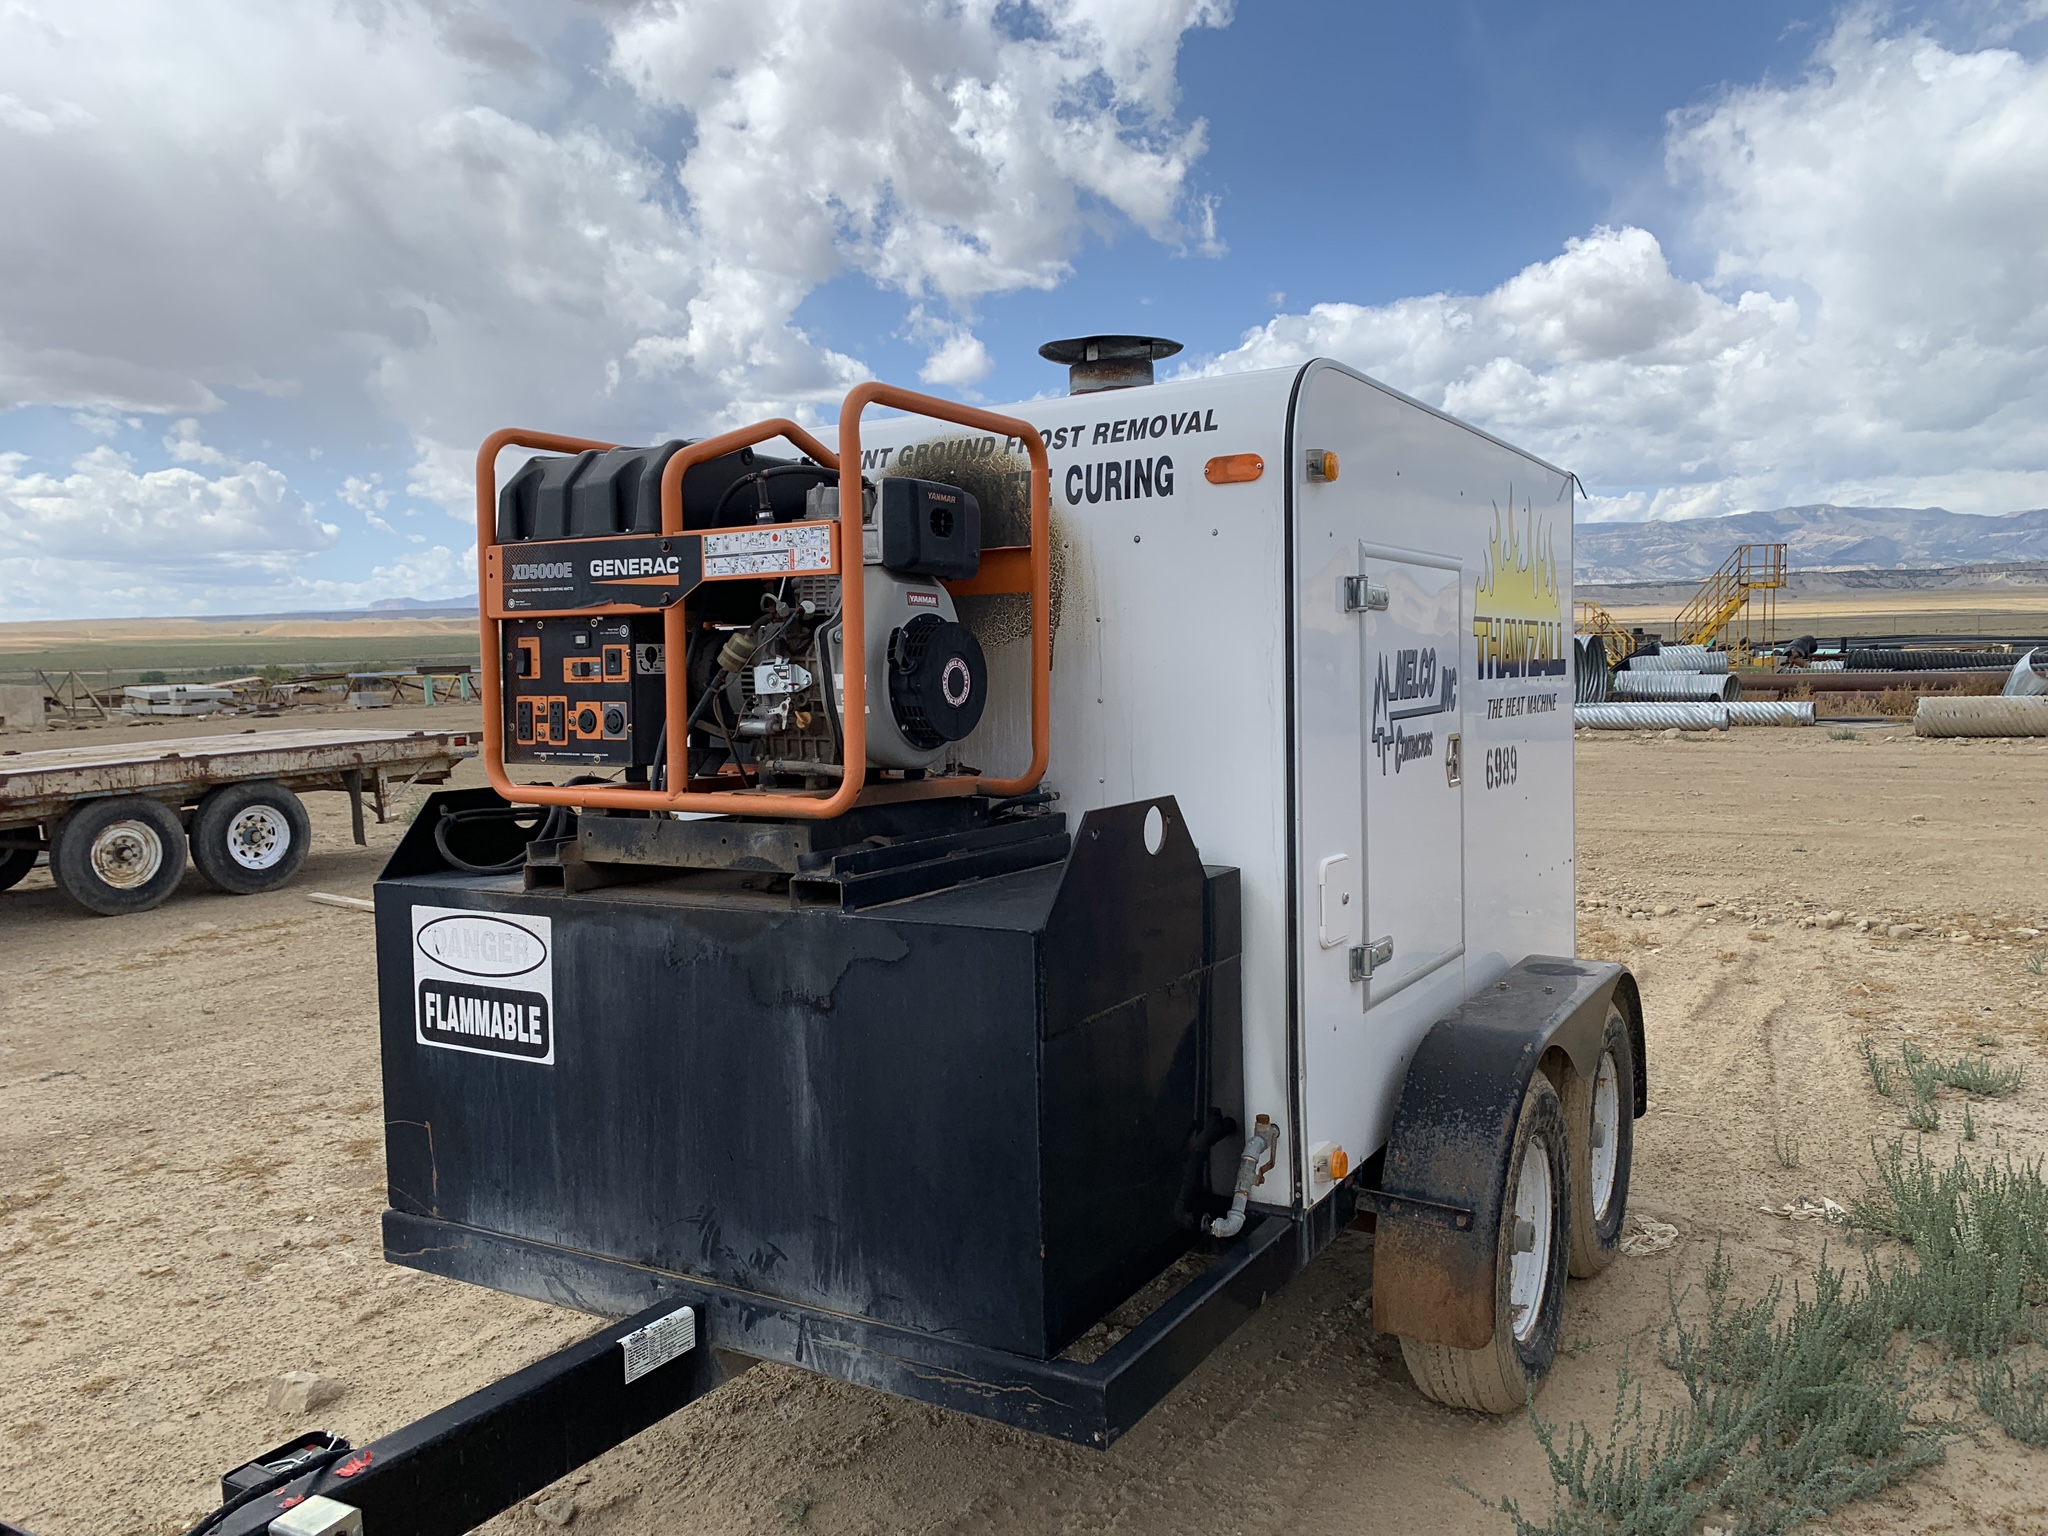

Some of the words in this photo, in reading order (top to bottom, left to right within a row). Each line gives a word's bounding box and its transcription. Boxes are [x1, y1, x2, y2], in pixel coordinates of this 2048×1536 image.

[898, 436, 996, 467] GROUND
[1092, 409, 1219, 446] REMOVAL
[927, 491, 956, 504] YANMAR
[1065, 455, 1174, 506] CURING
[512, 562, 573, 580] XD5000E
[590, 557, 679, 577] GENERAC
[909, 594, 937, 605] YANMAR
[1473, 616, 1566, 680] THAWZALL
[1396, 647, 1437, 701] NELCO
[1441, 665, 1457, 713] INC
[1487, 700, 1503, 720] THE
[1505, 698, 1524, 718] HEAT
[1527, 693, 1557, 715] MACHINE
[1486, 745, 1517, 790] 6989
[431, 926, 530, 966] DANGER
[425, 992, 542, 1045] FLAMMABLE
